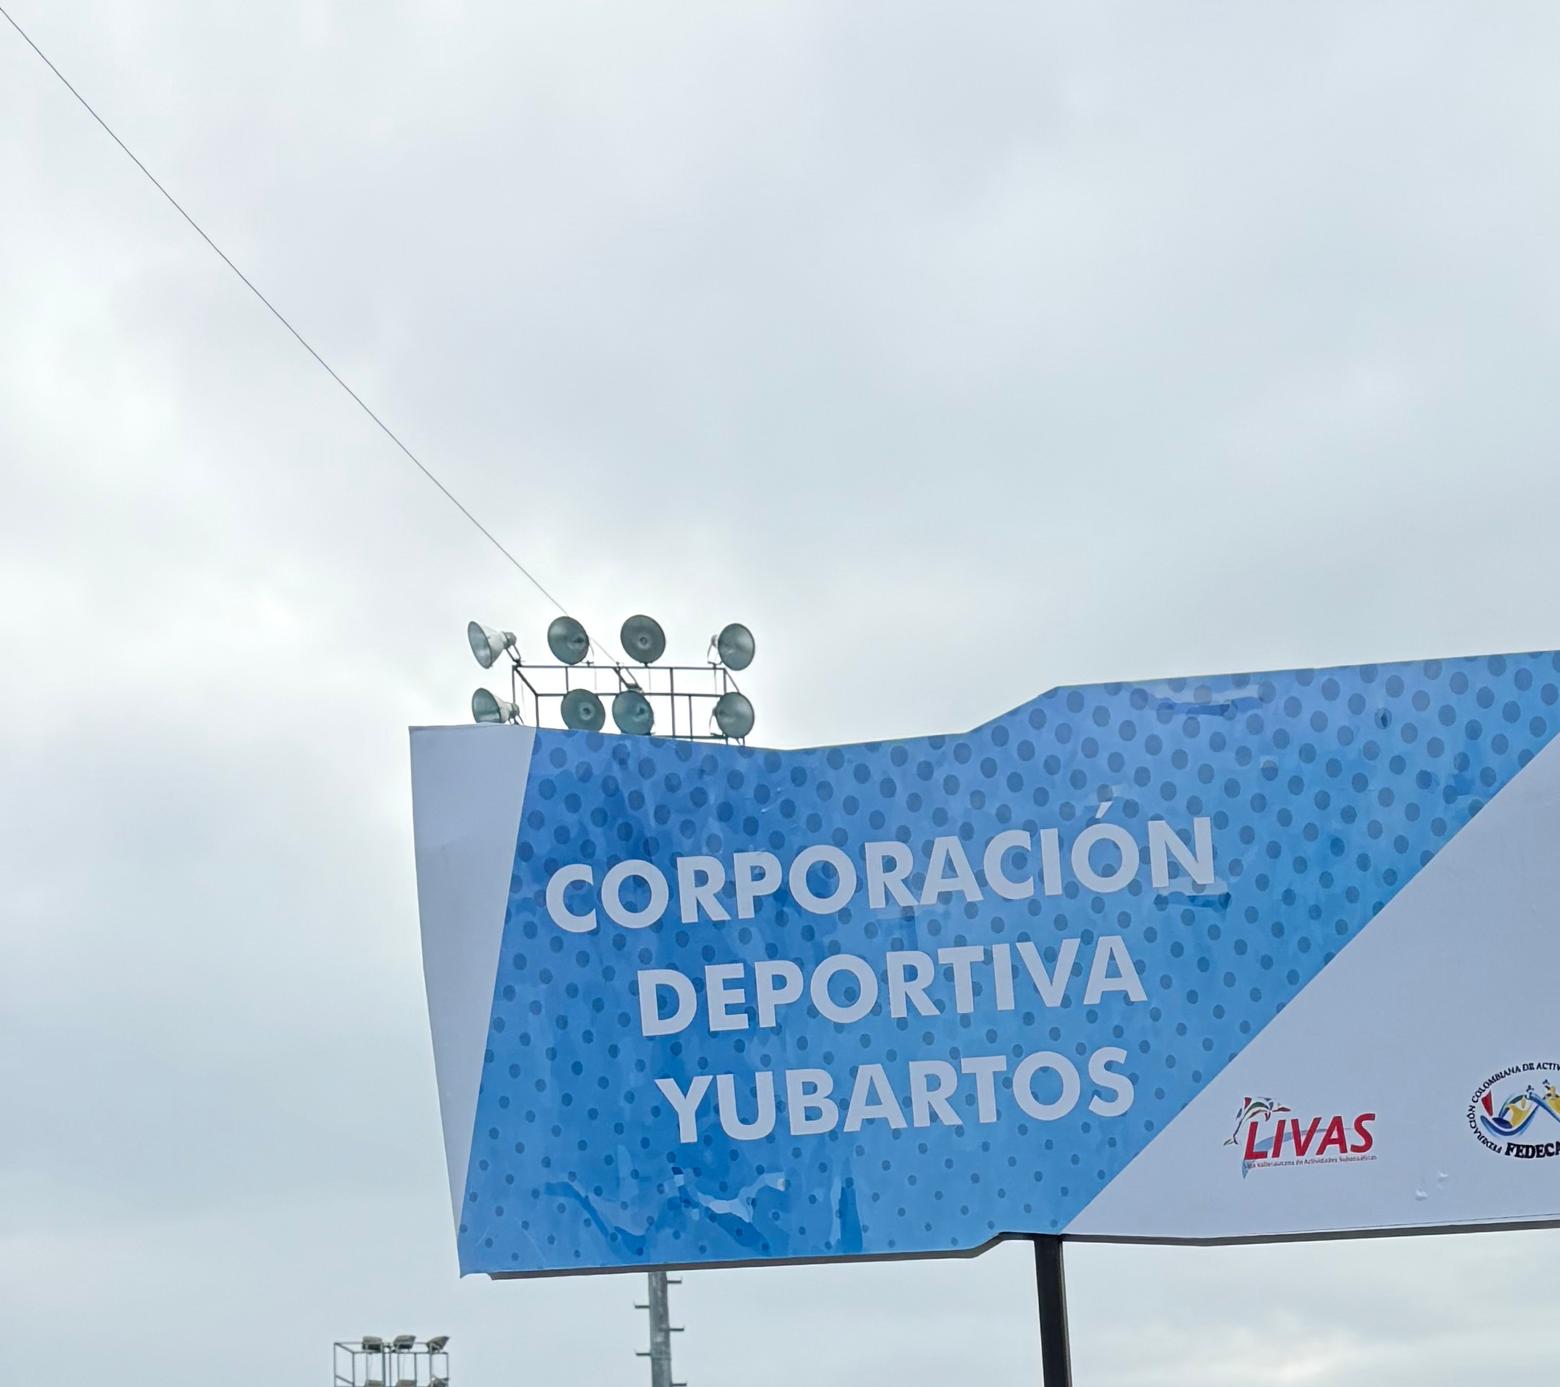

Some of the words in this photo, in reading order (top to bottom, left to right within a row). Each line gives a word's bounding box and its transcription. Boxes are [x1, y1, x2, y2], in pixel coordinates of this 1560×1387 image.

[545, 801, 1216, 934] CORPORACIÓN
[637, 935, 1148, 1037] DEPORTIVA
[655, 1047, 1135, 1145] YUBARTOS
[1522, 1062, 1535, 1072] DE
[1243, 1112, 1376, 1161] LIVAS
